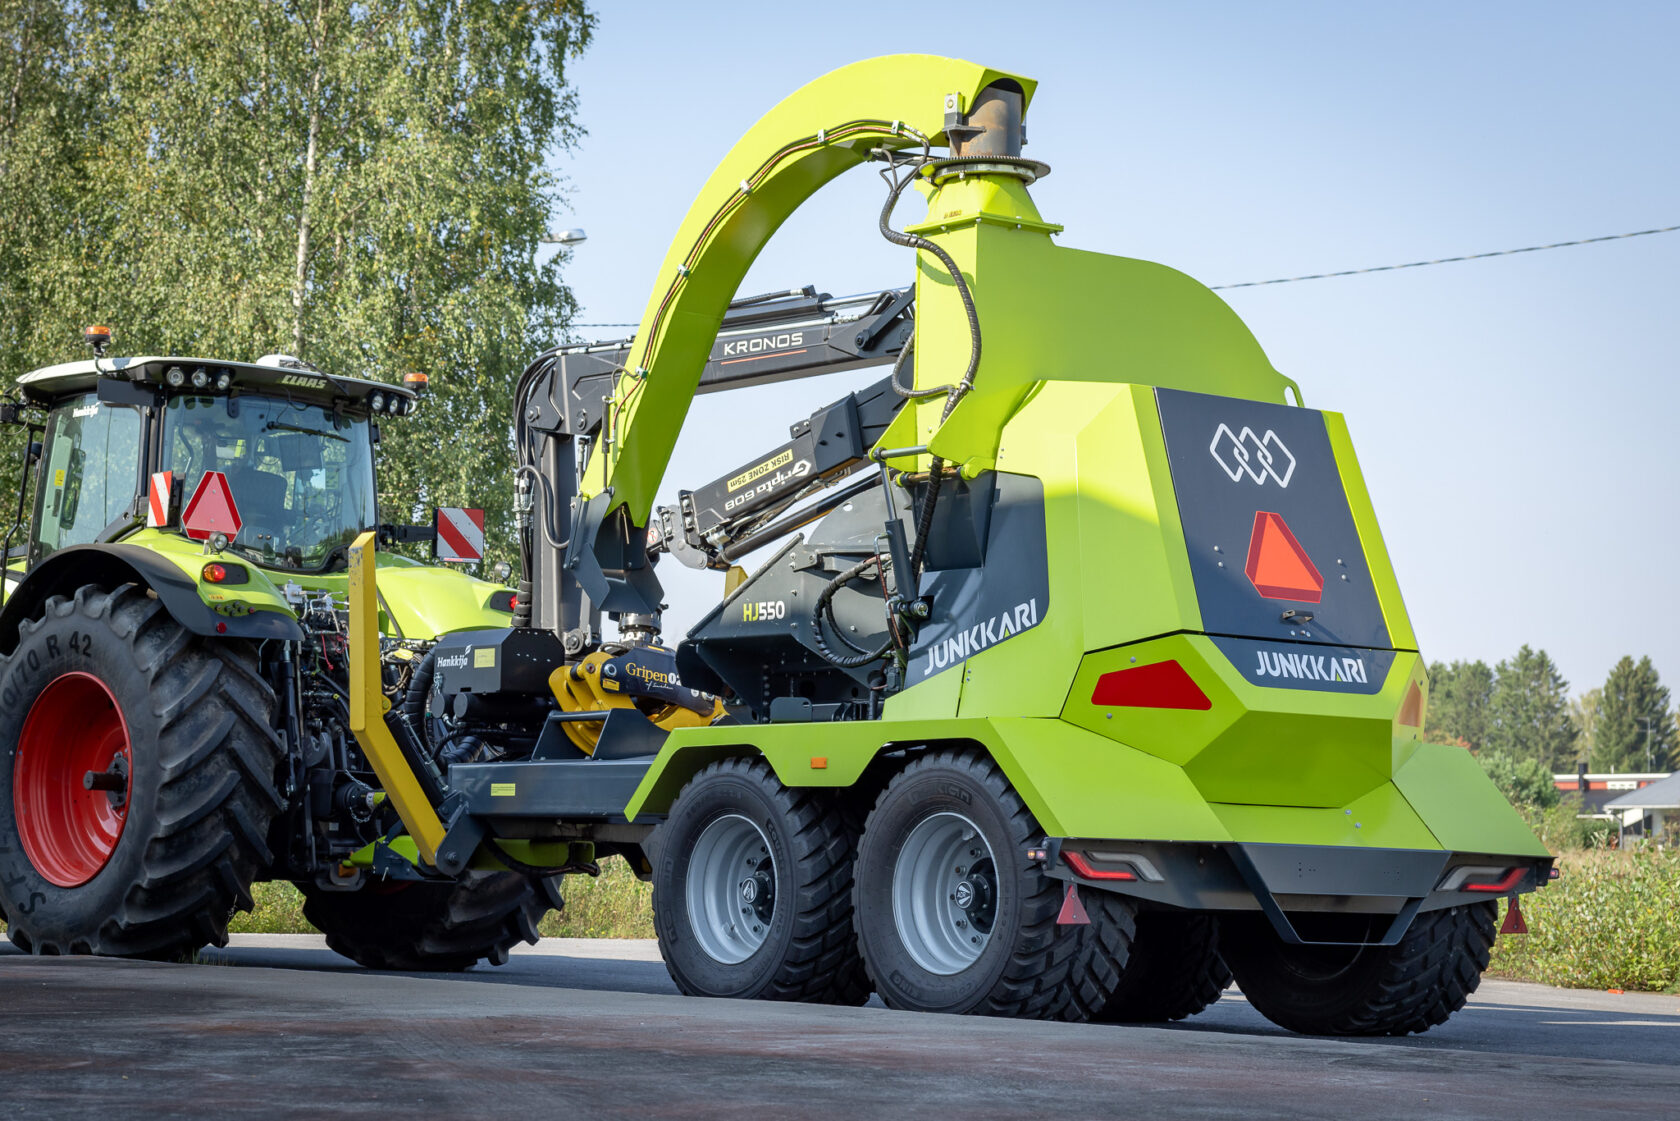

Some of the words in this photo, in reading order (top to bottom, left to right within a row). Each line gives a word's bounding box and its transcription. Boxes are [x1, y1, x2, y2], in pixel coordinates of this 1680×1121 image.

[724, 332, 803, 356] KRONOS
[281, 374, 328, 389] CLAAS
[750, 462, 769, 480] ZONE
[772, 452, 790, 468] RISK
[730, 476, 746, 488] 25m
[757, 460, 811, 493] Gripto
[725, 489, 755, 511] 608
[743, 600, 785, 622] HJ550
[46, 633, 60, 659] R
[69, 630, 92, 658] 42
[924, 598, 1037, 676] JUNKKARI
[437, 655, 469, 669] Hankkija
[1256, 650, 1368, 684] JUNKKARI
